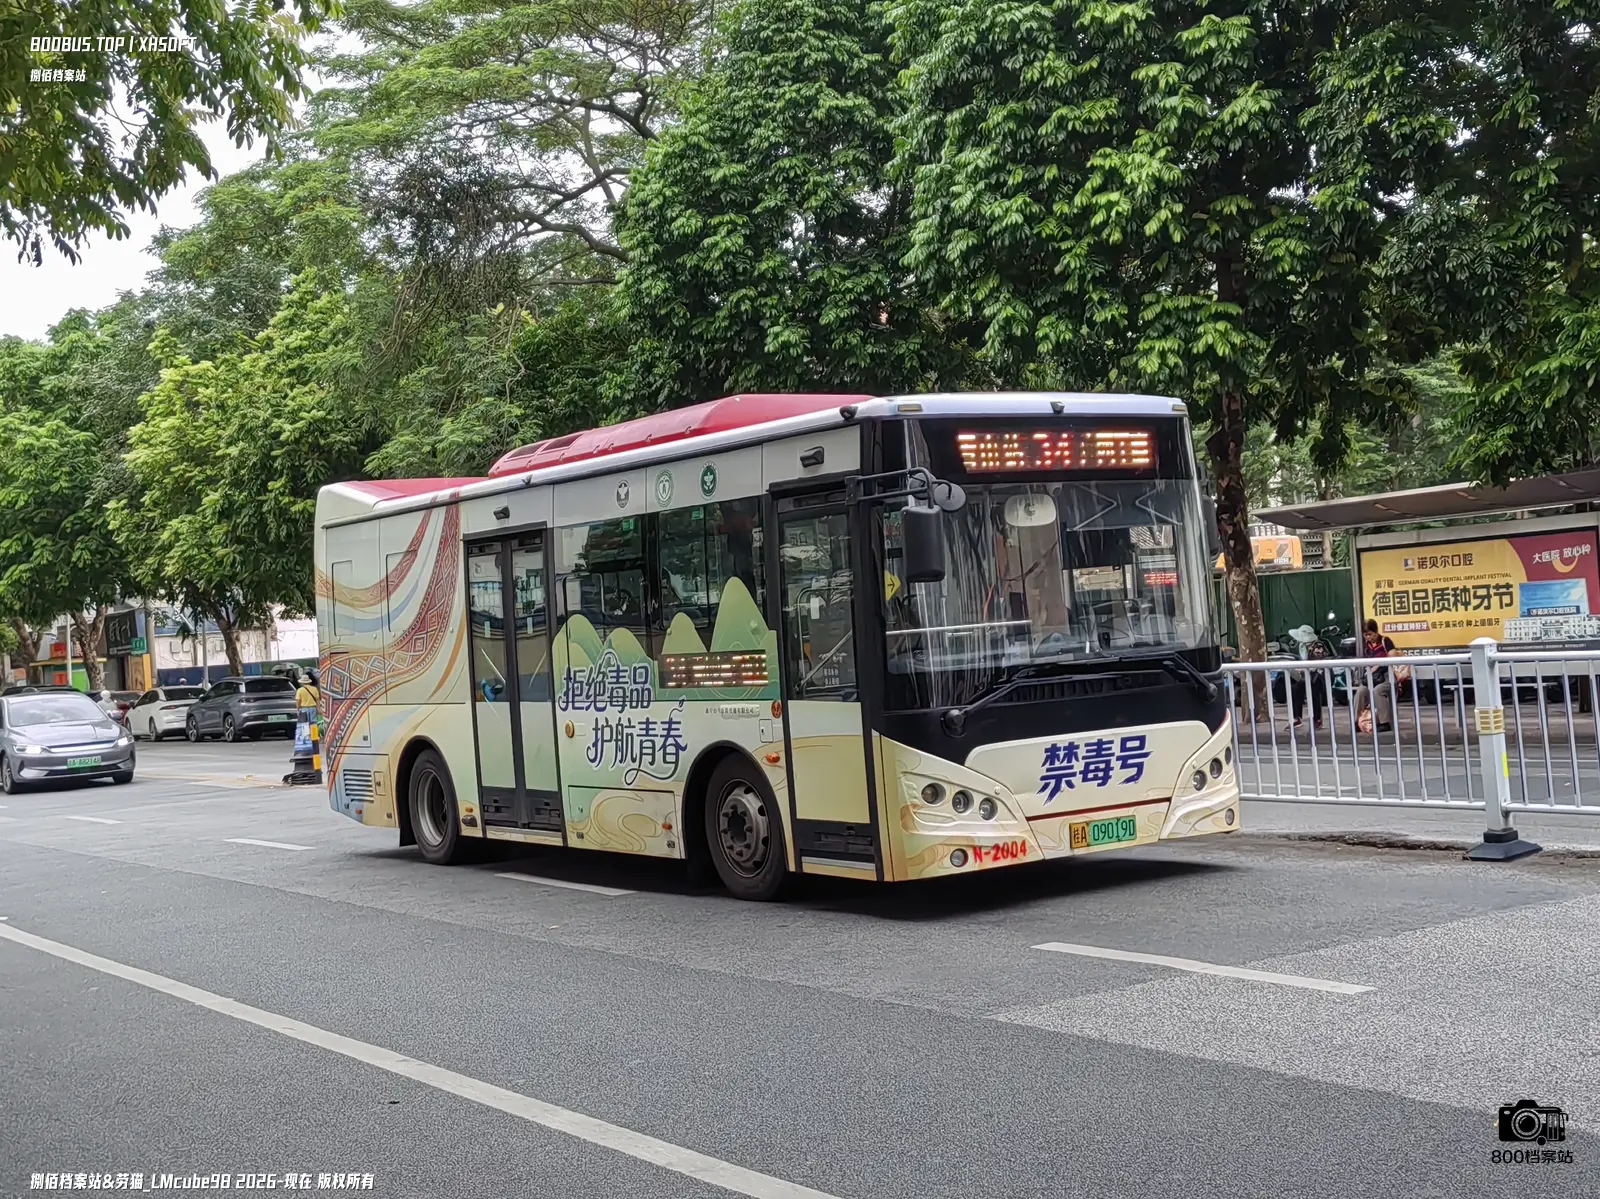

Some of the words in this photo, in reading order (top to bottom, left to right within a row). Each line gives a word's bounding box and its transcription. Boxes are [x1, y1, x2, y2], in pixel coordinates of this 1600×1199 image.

[1417, 553, 1474, 570] 诺贝尔口腔
[1532, 550, 1561, 564] 大医院
[1563, 543, 1592, 558] 放心种
[1372, 582, 1514, 616] 德国品质种牙节
[558, 660, 652, 713] 拒绝毒品
[587, 705, 688, 776] 护航青春
[1037, 734, 1154, 806] 禁毒号
[1073, 825, 1088, 845] 桂A
[1092, 818, 1135, 842] 09019D
[972, 839, 1028, 864] N-2004
